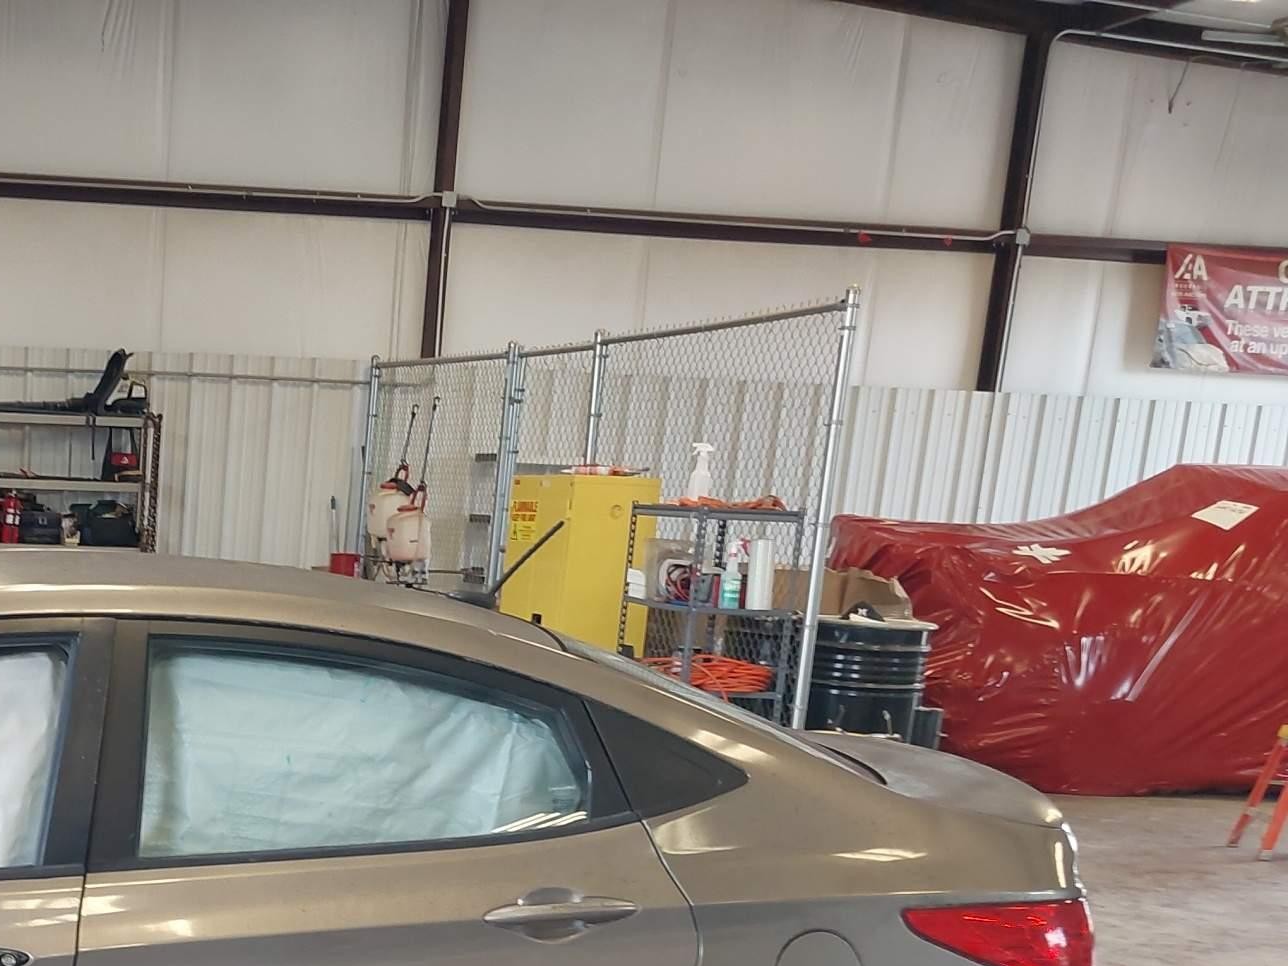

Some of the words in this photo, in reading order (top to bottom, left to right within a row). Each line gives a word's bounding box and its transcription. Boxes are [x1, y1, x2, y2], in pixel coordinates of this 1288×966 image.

[1226, 319, 1269, 337] These
[1231, 338, 1245, 353] at
[1247, 341, 1266, 354] an
